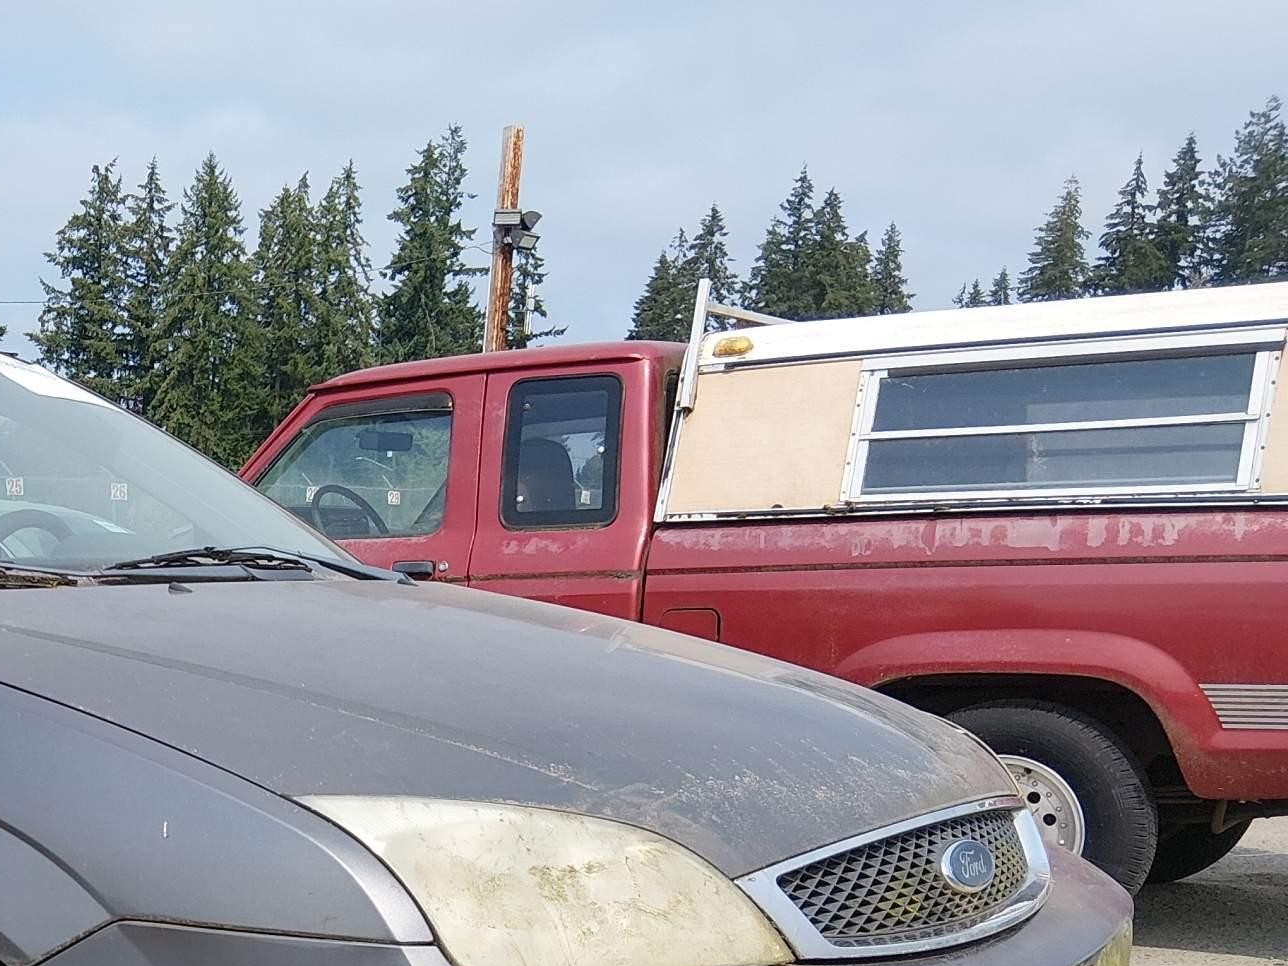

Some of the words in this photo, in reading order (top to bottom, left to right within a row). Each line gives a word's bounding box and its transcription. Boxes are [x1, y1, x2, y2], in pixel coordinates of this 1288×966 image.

[7, 479, 22, 495] 25
[112, 484, 126, 499] 26
[959, 850, 987, 879] Ford
